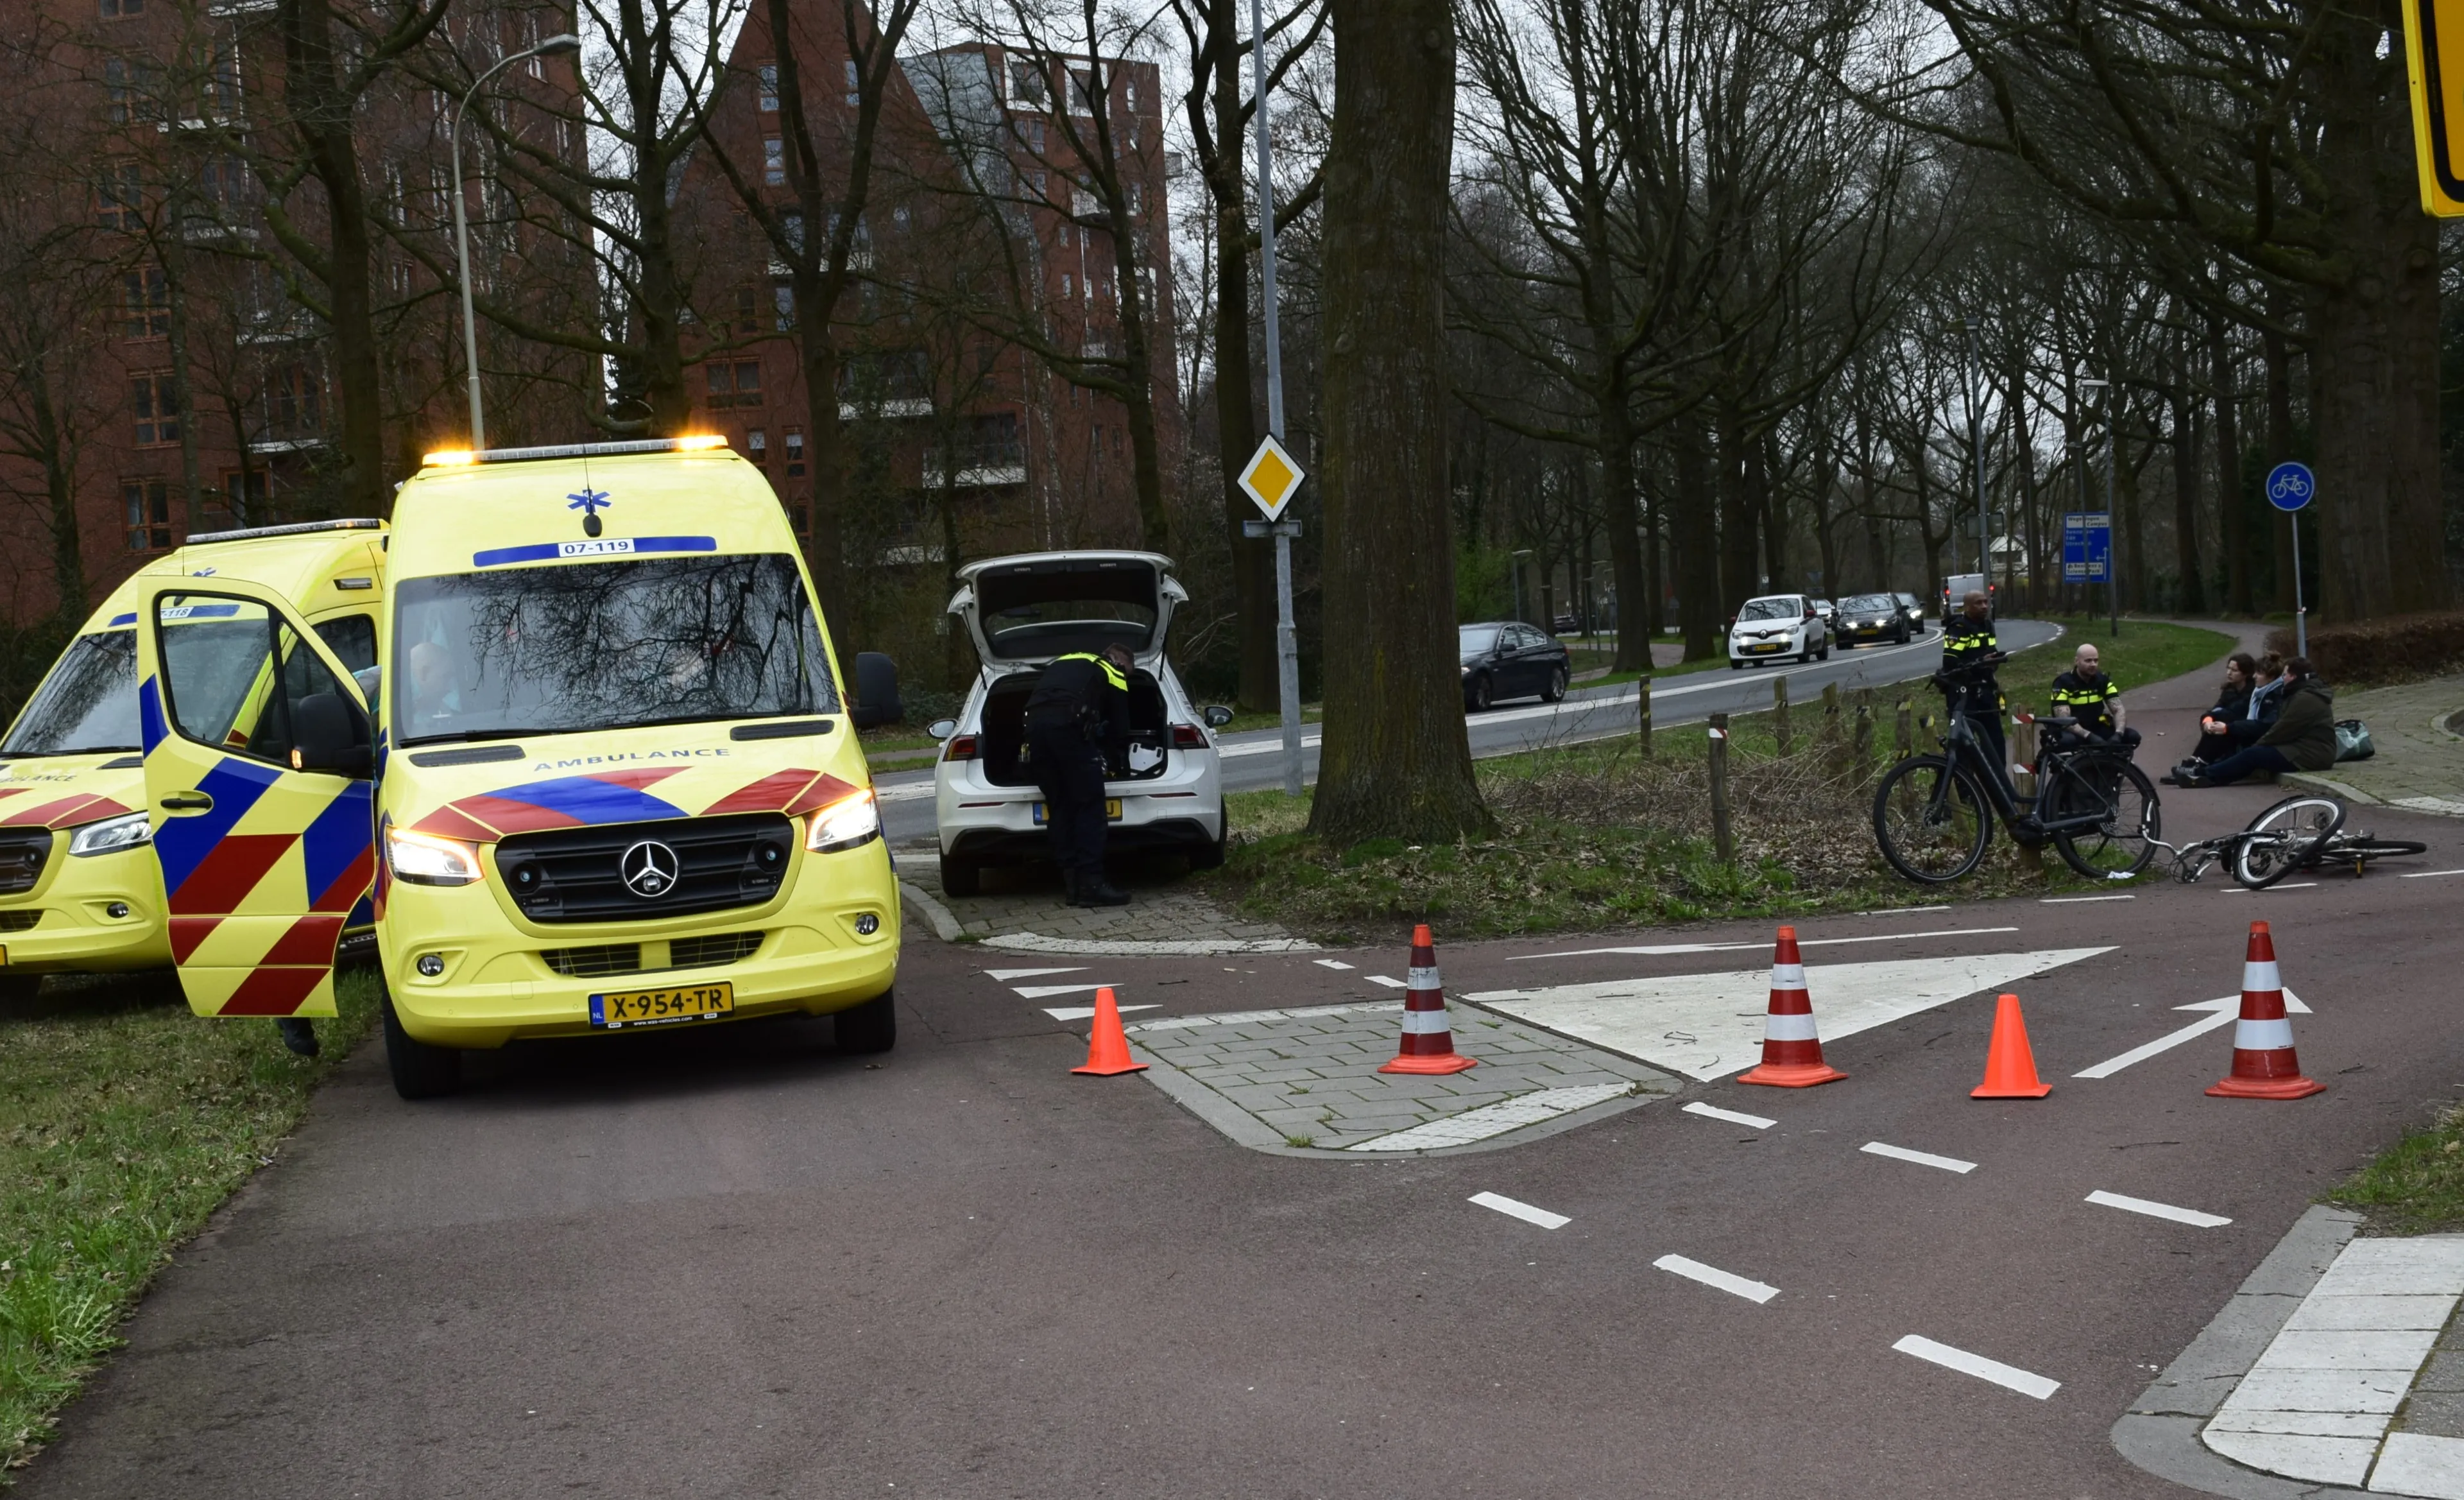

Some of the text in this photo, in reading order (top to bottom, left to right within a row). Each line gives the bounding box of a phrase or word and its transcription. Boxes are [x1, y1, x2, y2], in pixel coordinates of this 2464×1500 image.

[565, 541, 629, 554] 07-119
[160, 608, 189, 617] 7-118
[534, 748, 731, 772] AMBULANCE
[0, 775, 78, 783] BULANCE
[612, 989, 724, 1019] X-954-TR
[633, 1016, 693, 1026] www.was-vehicles.com
